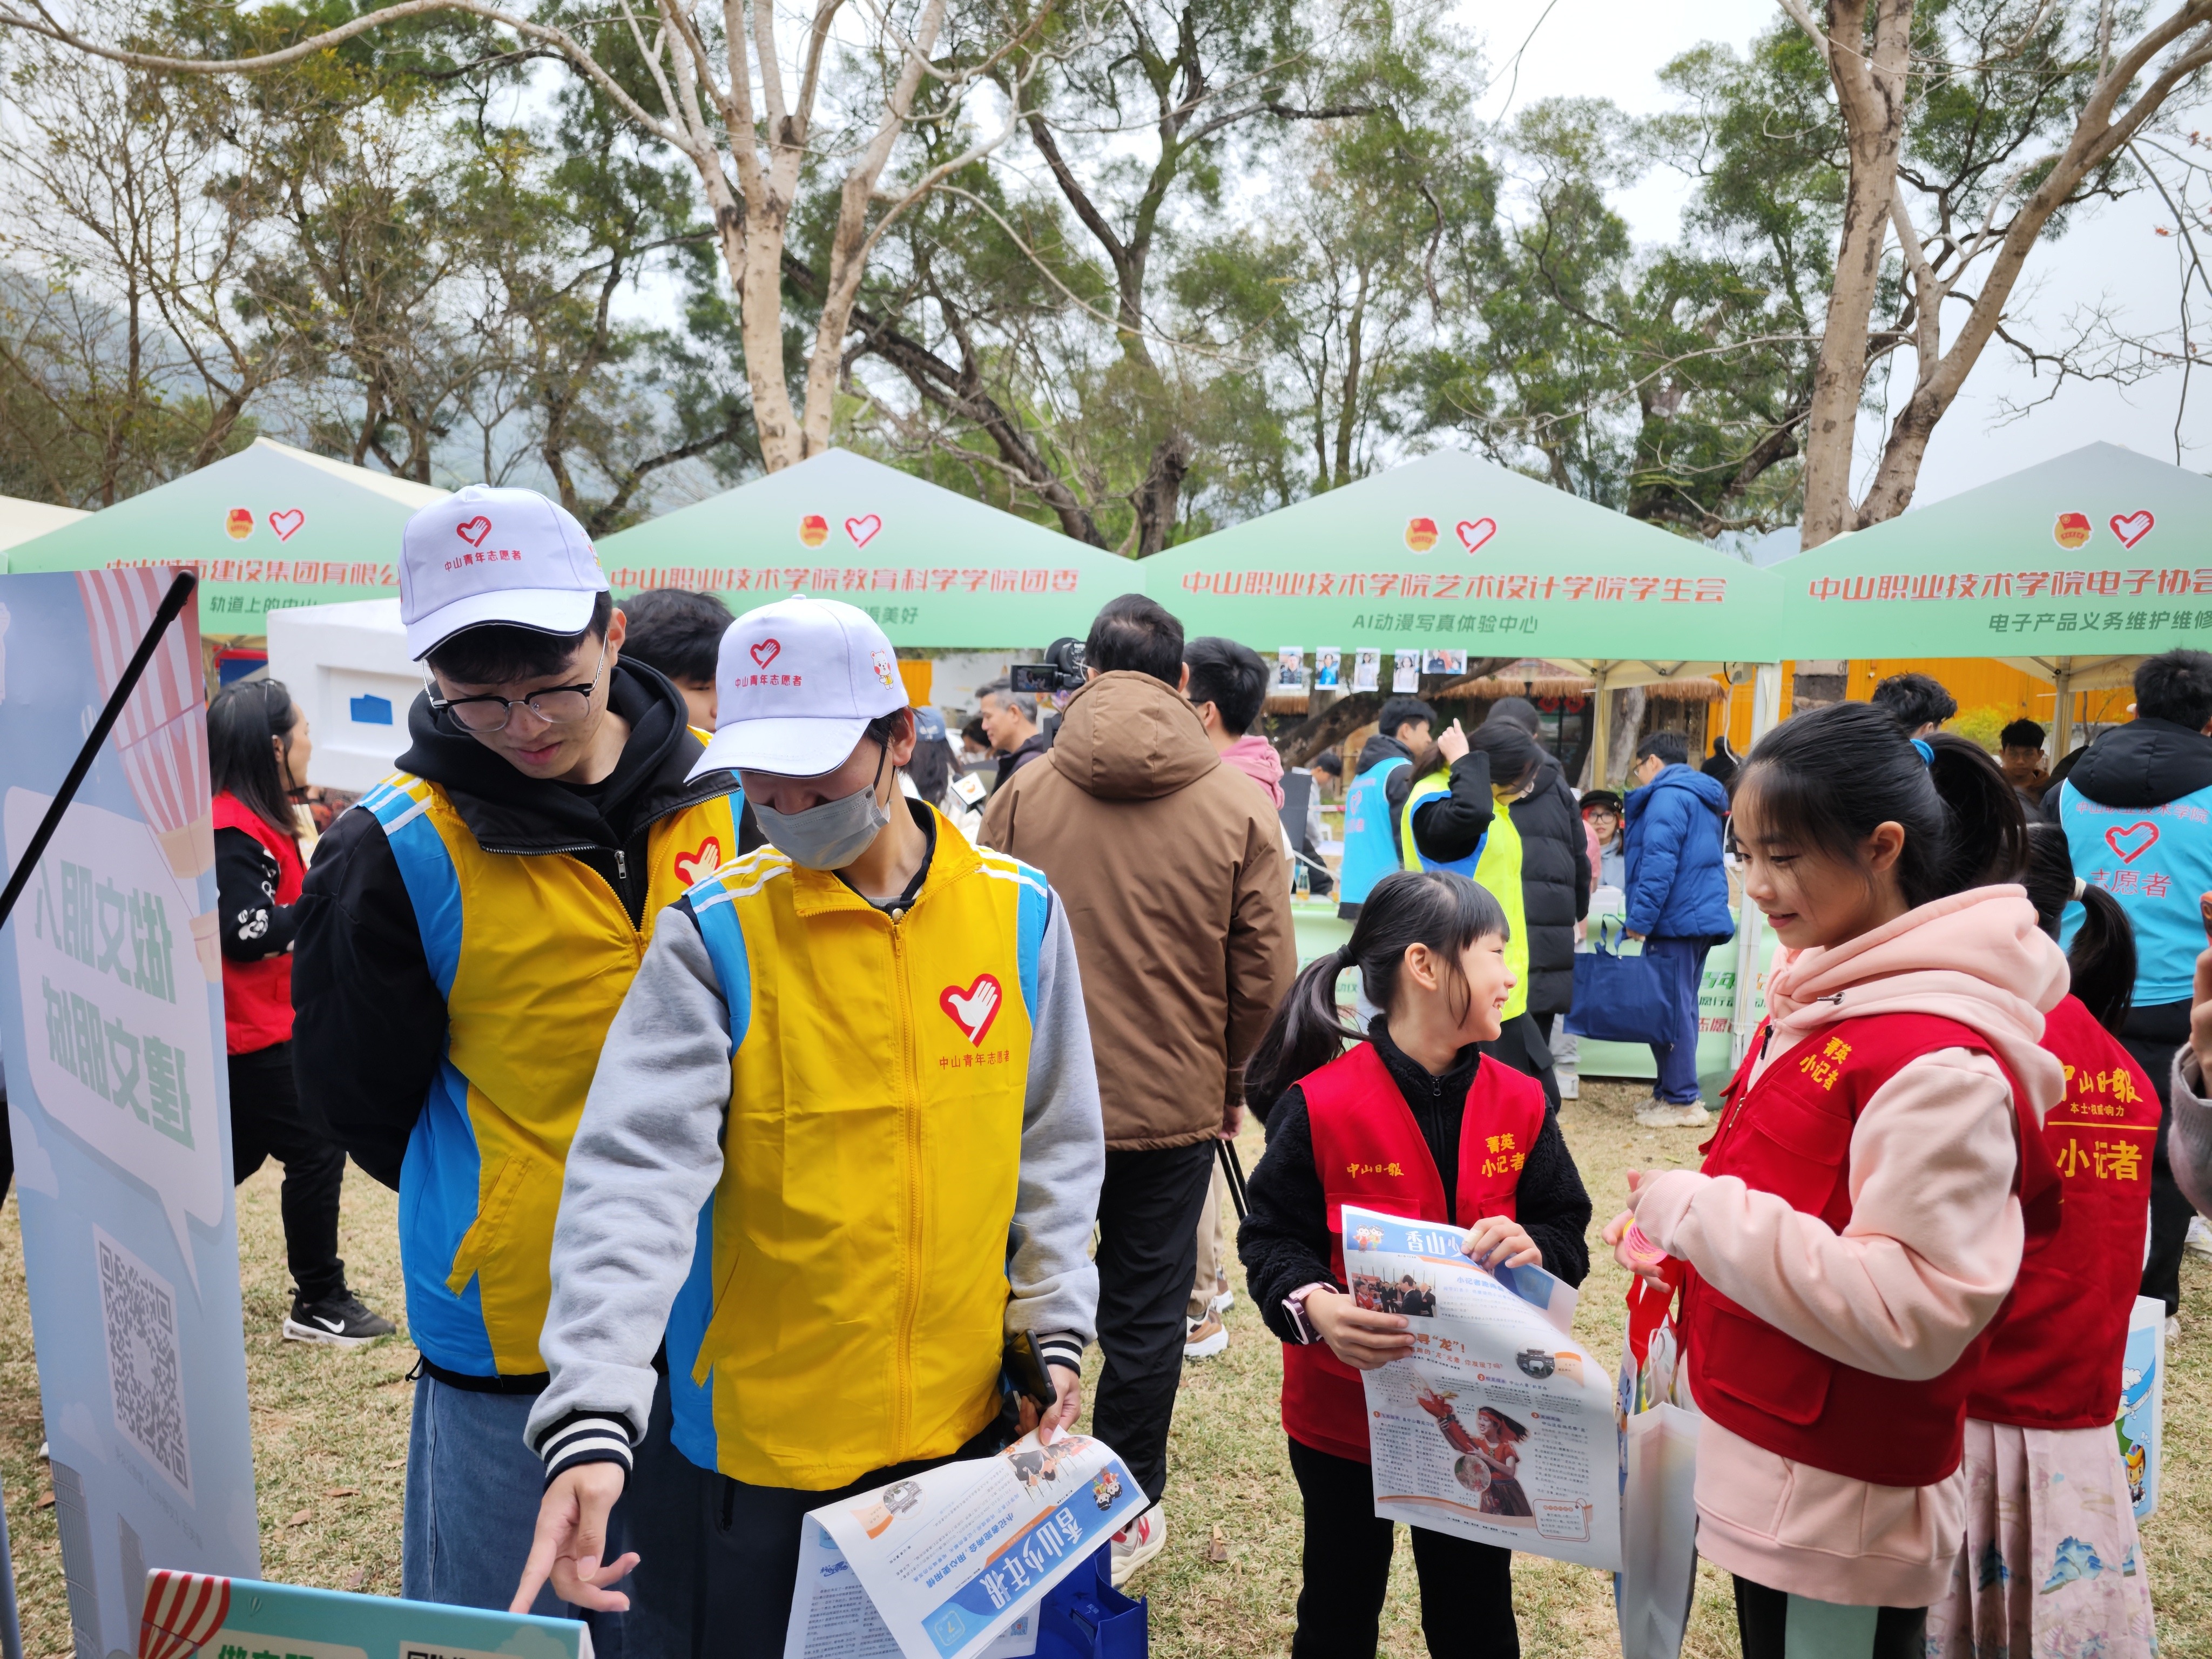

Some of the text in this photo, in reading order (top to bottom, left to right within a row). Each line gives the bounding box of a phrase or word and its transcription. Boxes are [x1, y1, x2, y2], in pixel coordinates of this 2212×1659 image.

[444, 550, 522, 572] 中山青年志愿者
[610, 567, 1079, 592] 中山职业技术学院教育科学学院团委
[1181, 570, 1728, 603] 中山职业技术学院艺术设计学院学生会
[1352, 612, 1539, 634] AI动漫写真体验中心
[1988, 610, 2212, 633] 电子产品义务维护维修
[735, 675, 802, 689] 中山青年志愿者
[2091, 868, 2171, 898] 志愿者
[939, 1050, 1009, 1070] 中山青年志愿者
[1823, 1036, 1852, 1064] 菁英
[1799, 1054, 1839, 1091] 小记者
[1485, 1132, 1515, 1154] 菁英
[1481, 1152, 1526, 1178] 小记者
[2056, 1138, 2142, 1181] 小记者
[979, 1506, 1076, 1610] 香山少年报
